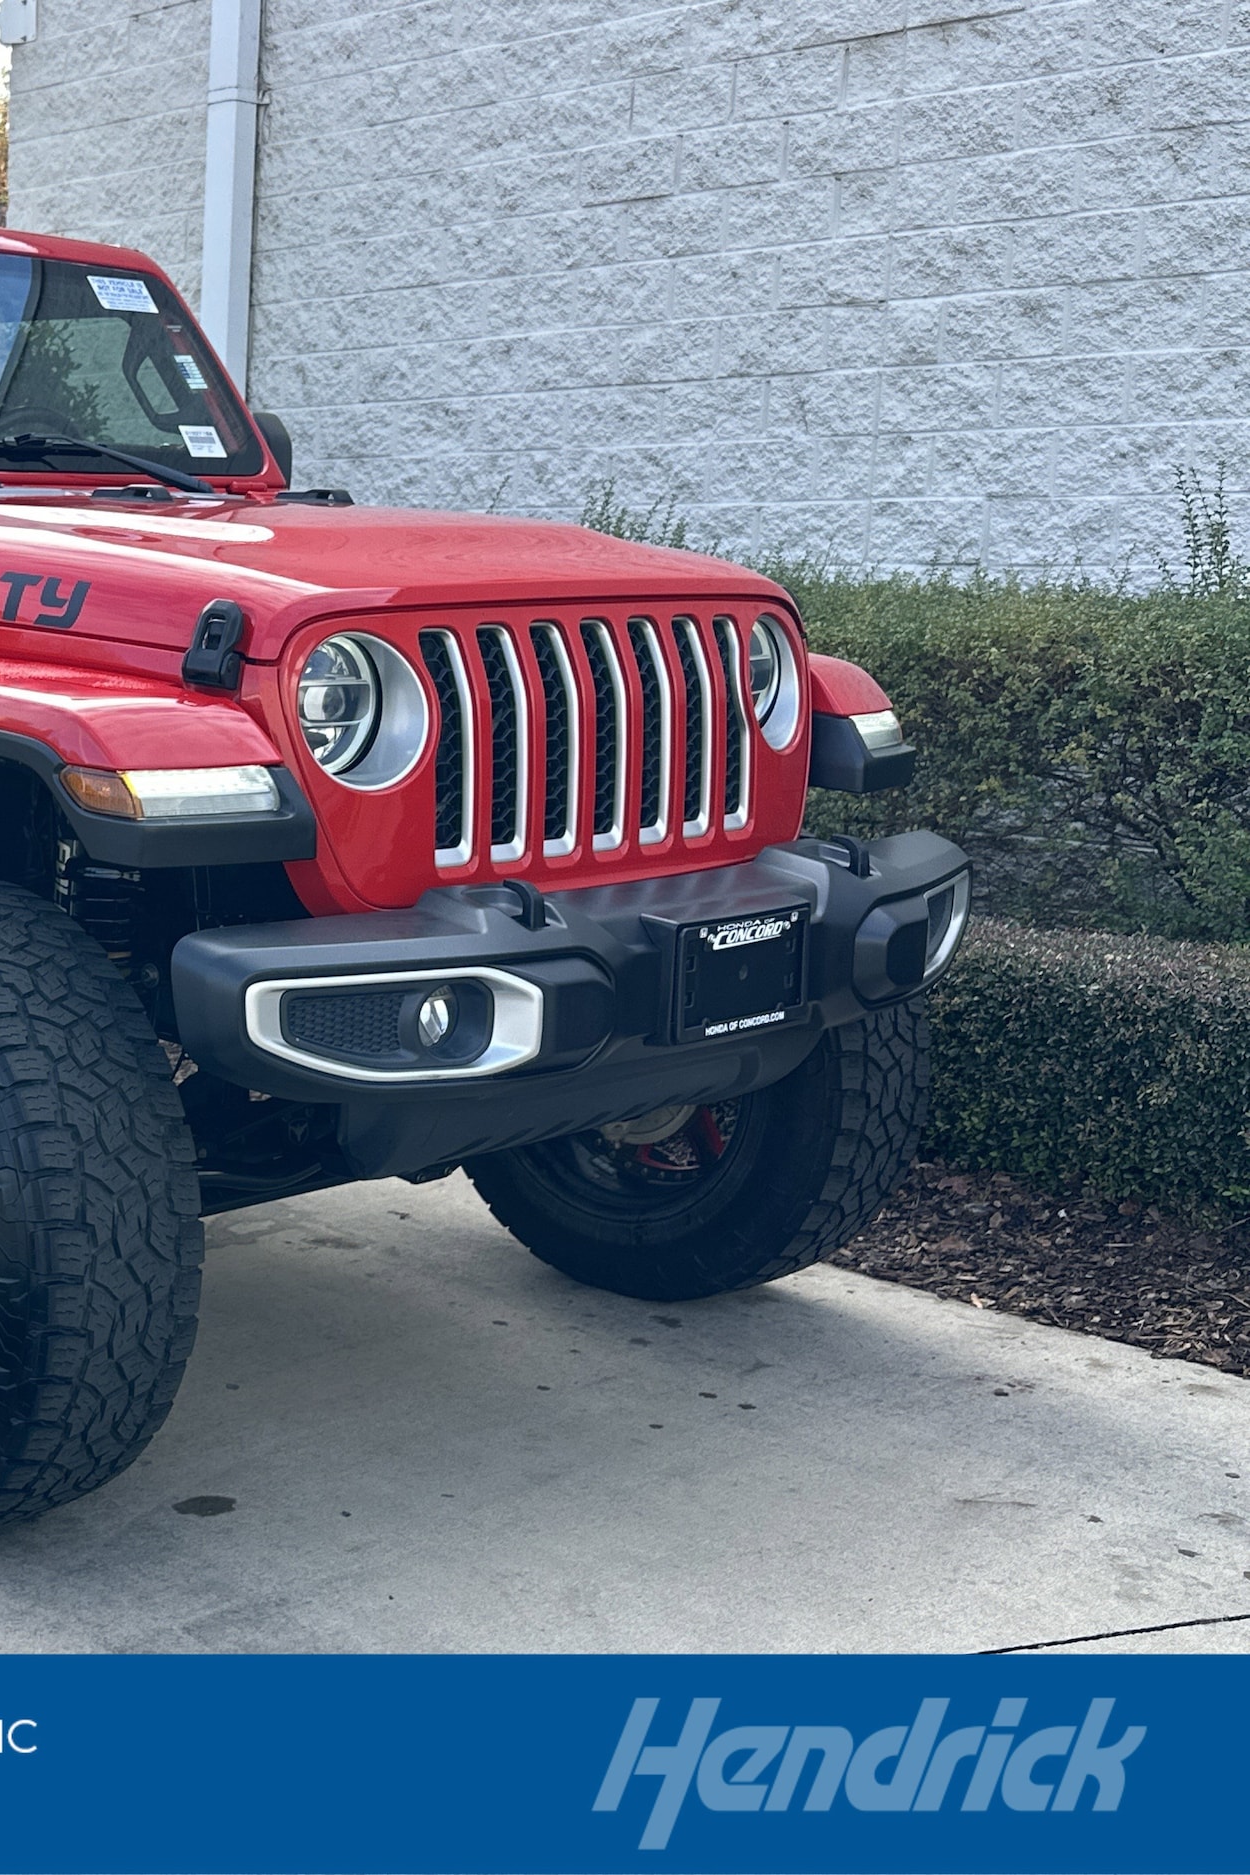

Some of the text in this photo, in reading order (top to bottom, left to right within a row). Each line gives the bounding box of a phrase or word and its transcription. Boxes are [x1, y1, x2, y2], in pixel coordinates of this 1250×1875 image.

[712, 921, 784, 950] CONCORD
[717, 917, 776, 932] HONDA OF
[705, 1011, 785, 1036] HONDA OF CONCORD.COM
